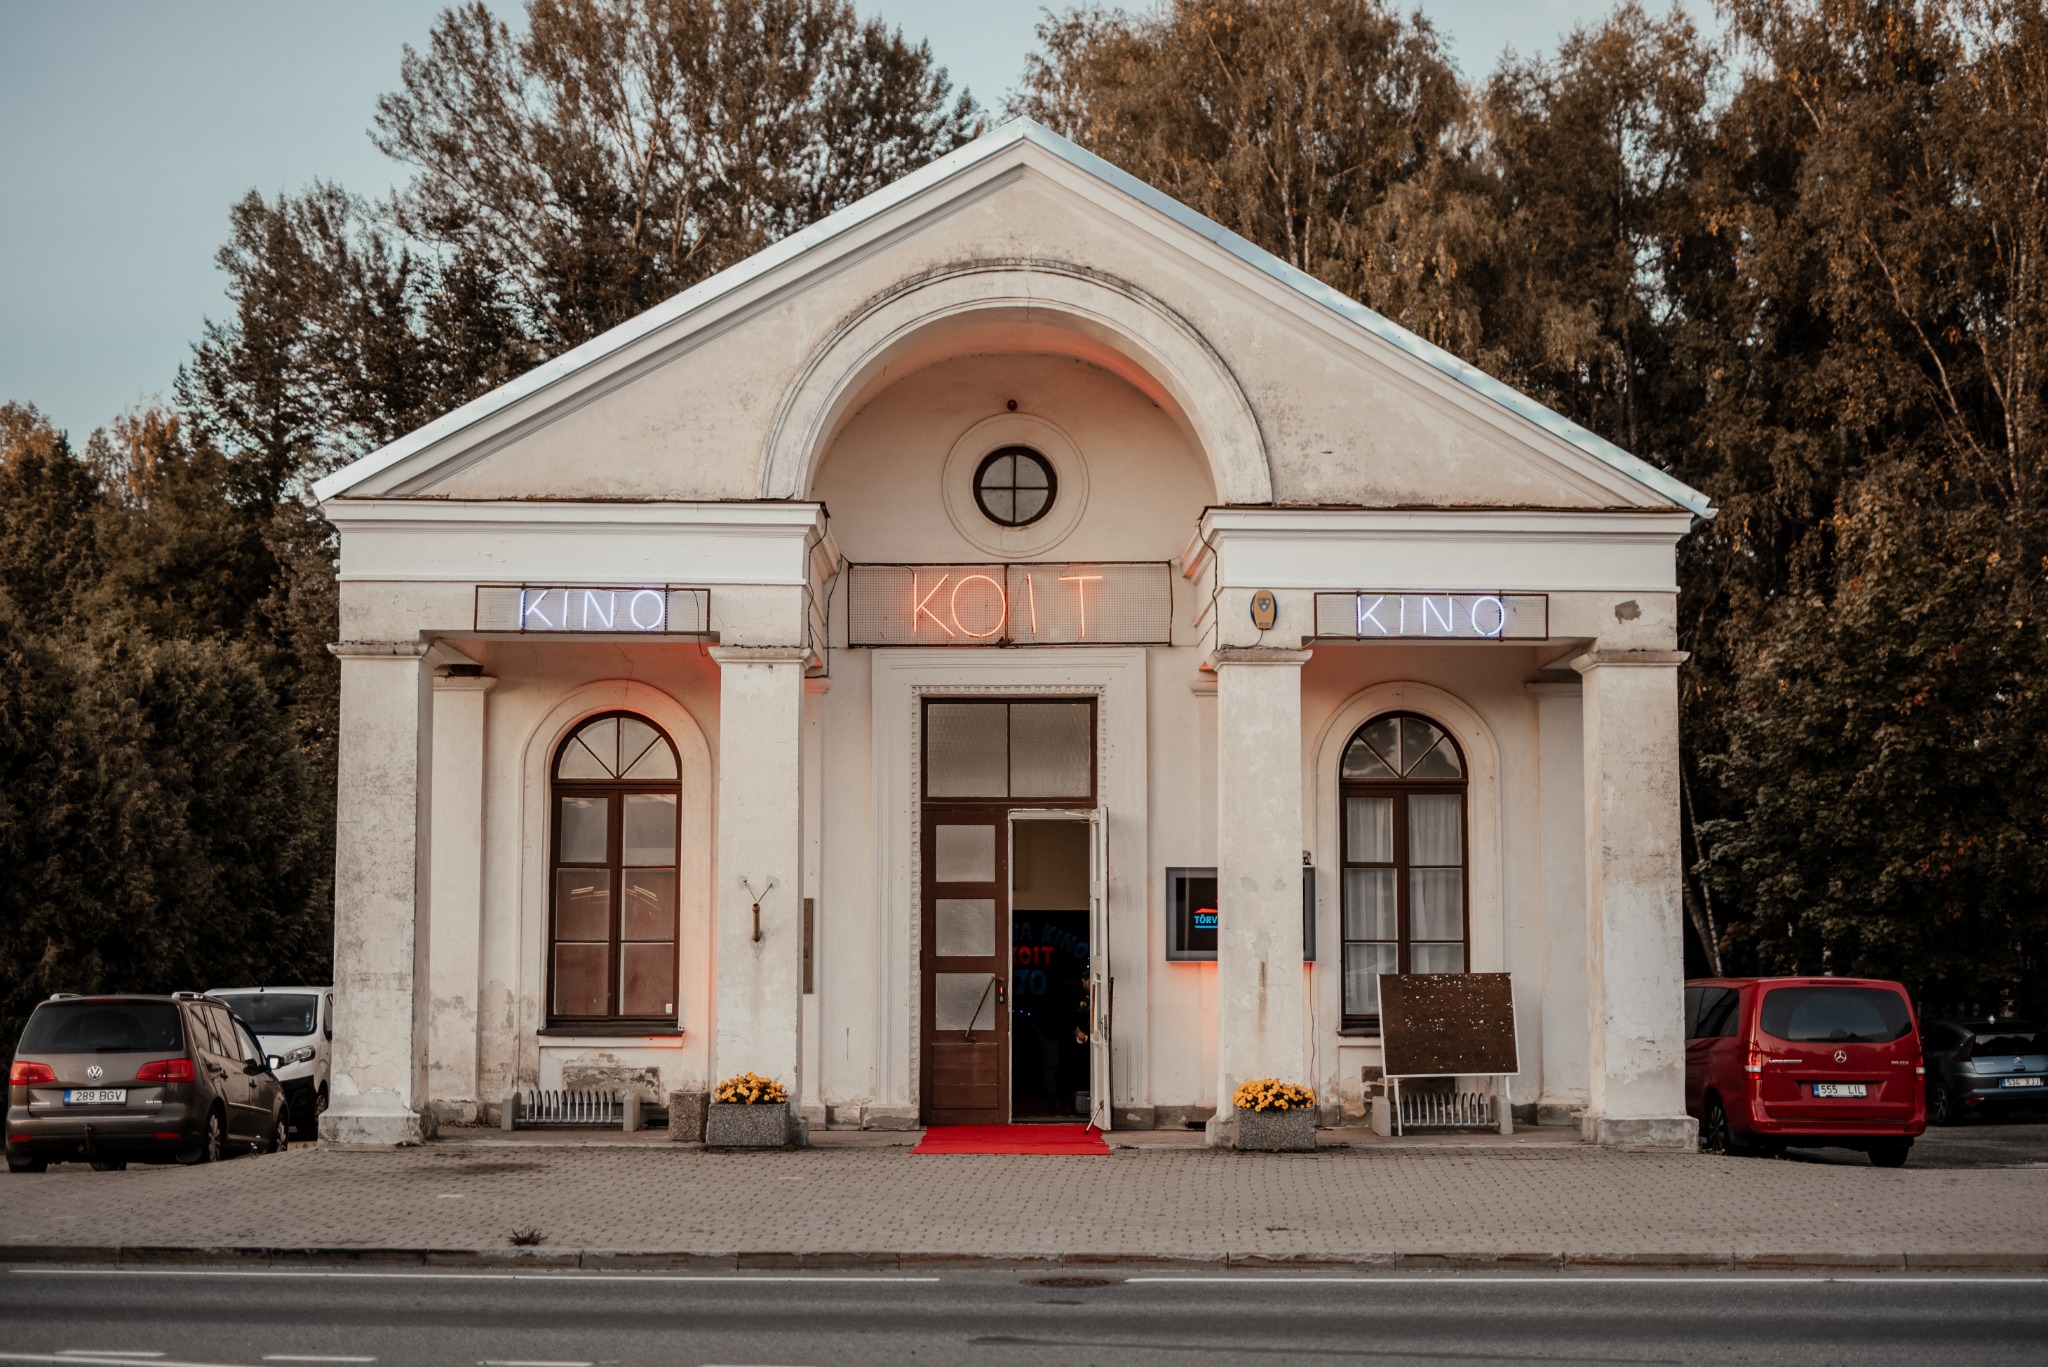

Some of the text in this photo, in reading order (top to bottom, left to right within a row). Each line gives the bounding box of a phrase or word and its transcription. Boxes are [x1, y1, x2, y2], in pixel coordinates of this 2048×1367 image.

[519, 589, 664, 629] KINO
[913, 573, 1103, 638] KOIT
[1357, 596, 1505, 636] KINO
[1040, 923, 1089, 959] KINO
[1014, 969, 1048, 995] 70
[76, 1091, 95, 1102] 289
[99, 1091, 123, 1101] BGV
[1820, 1085, 1864, 1094] 555 LIL
